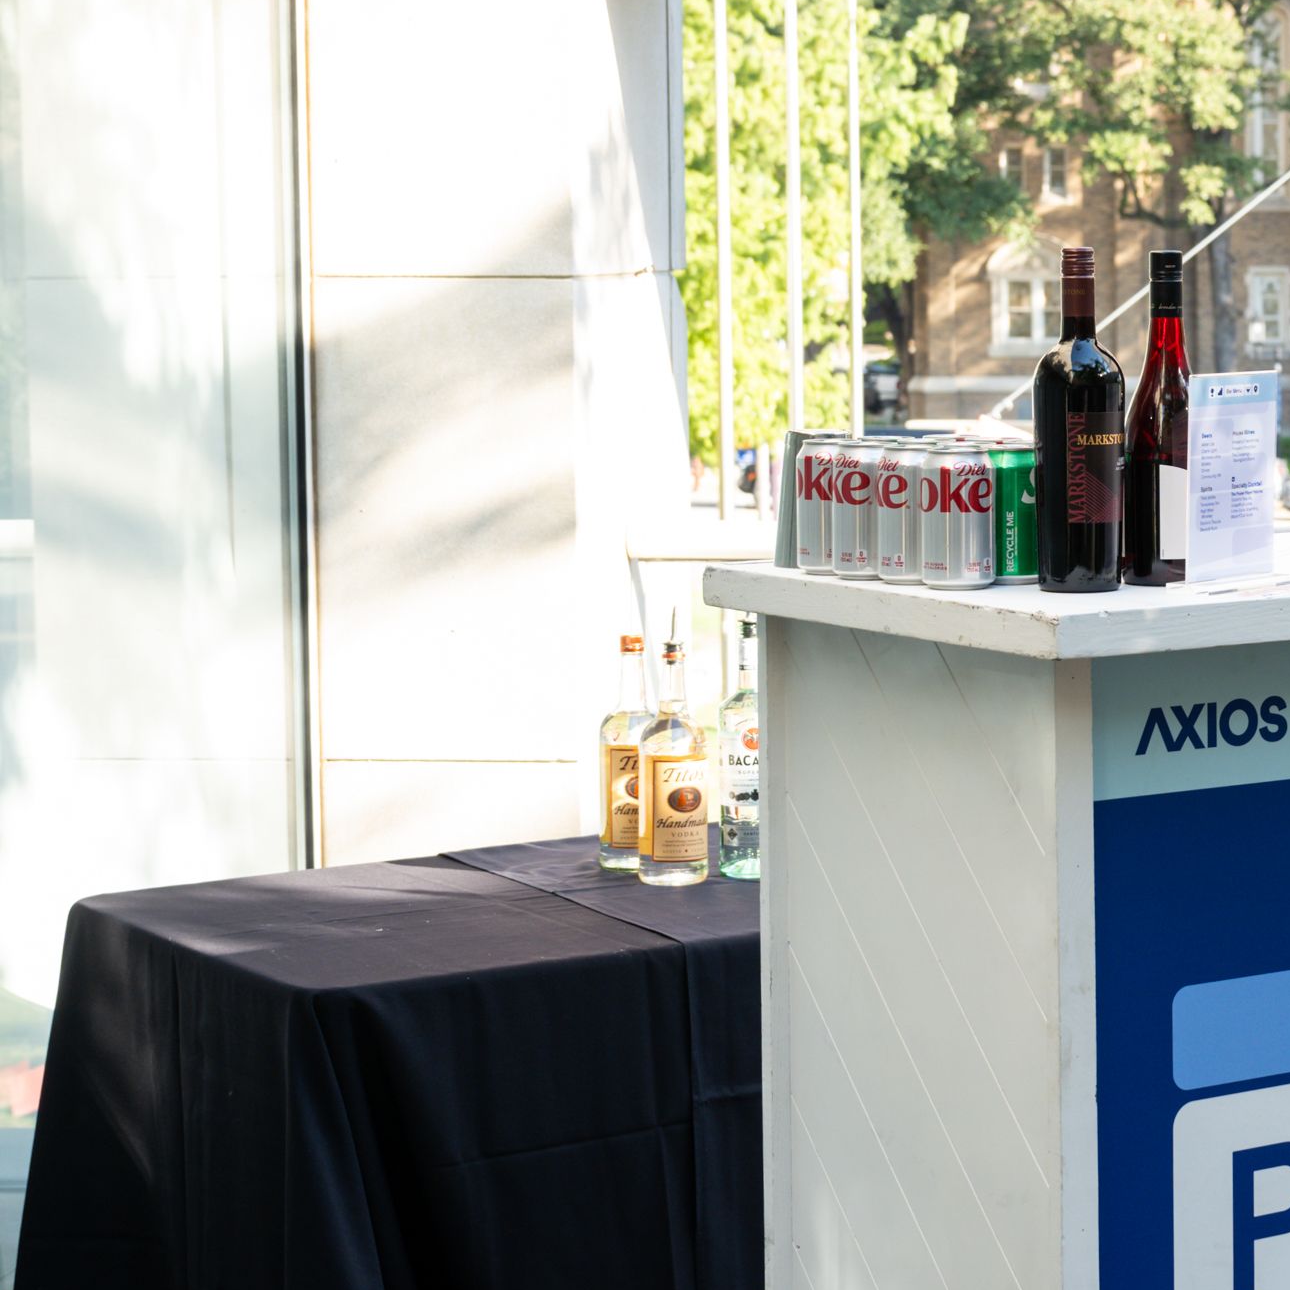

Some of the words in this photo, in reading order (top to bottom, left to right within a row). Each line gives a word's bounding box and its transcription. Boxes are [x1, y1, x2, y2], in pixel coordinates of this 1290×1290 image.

[1077, 433, 1124, 446] MARKSTO
[954, 461, 987, 477] Diet
[1068, 412, 1087, 524] MARKSTONE
[920, 466, 993, 513] oke
[1006, 511, 1014, 526] ME
[1006, 527, 1015, 572] RECYCLE
[1135, 696, 1288, 756] AXIOS
[729, 755, 759, 766] BACA
[657, 814, 707, 829] Handmad
